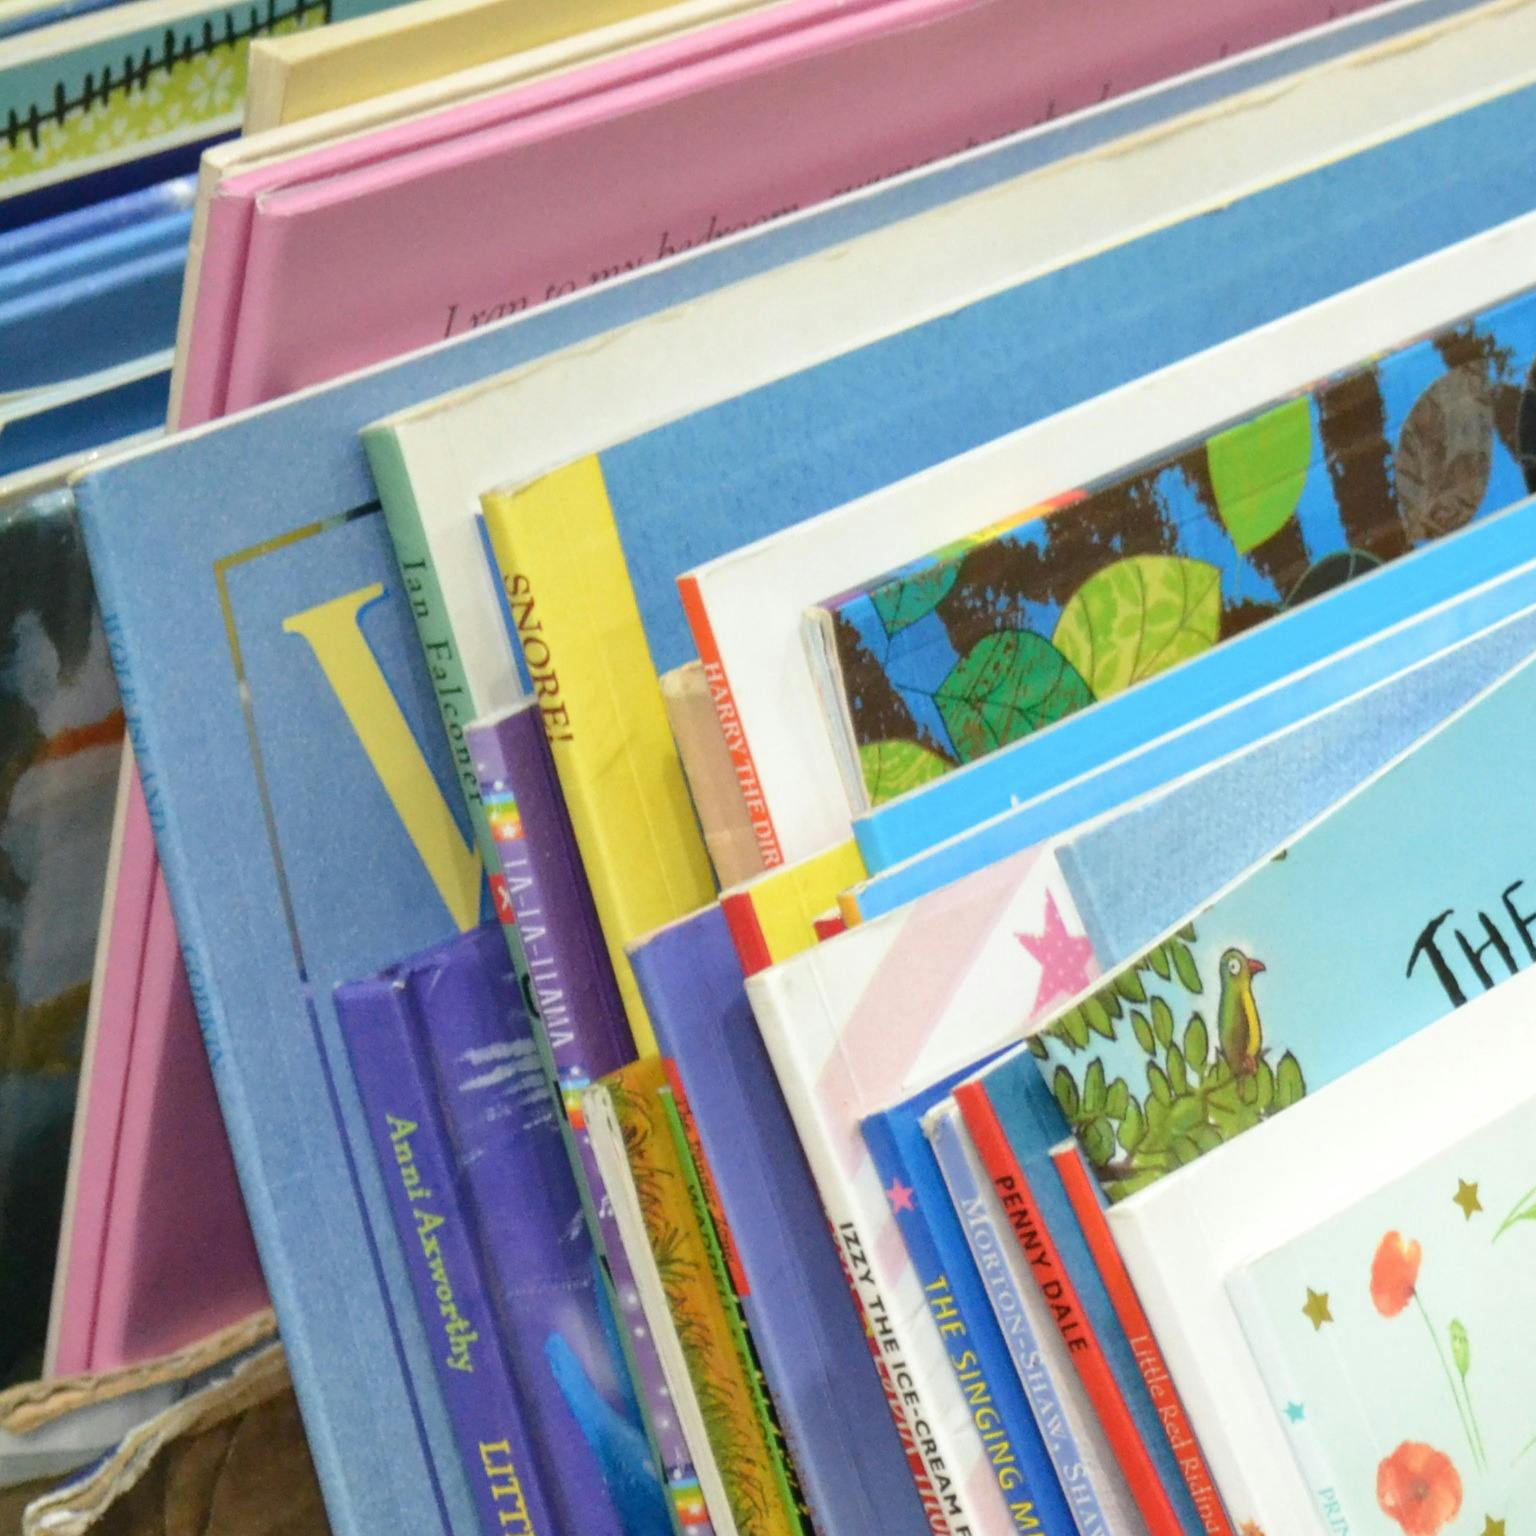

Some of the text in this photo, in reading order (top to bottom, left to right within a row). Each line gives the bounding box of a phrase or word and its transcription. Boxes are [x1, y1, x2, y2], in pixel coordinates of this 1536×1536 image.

[402, 558, 483, 806] Ian Falconer
[504, 572, 575, 746] SNORE!
[702, 660, 747, 752] HARRY
[733, 755, 764, 810] THE
[386, 1112, 481, 1375] Anni Axworthy
[996, 1174, 1088, 1354] PENNY DALE
[839, 1221, 875, 1287] IZZY
[867, 1297, 899, 1352] THE
[893, 1362, 961, 1516] ICE-CREAM
[925, 1276, 966, 1337] THE
[952, 1350, 1023, 1491] SINGING
[1131, 1334, 1164, 1399] Little
[1160, 1404, 1190, 1460] Red
